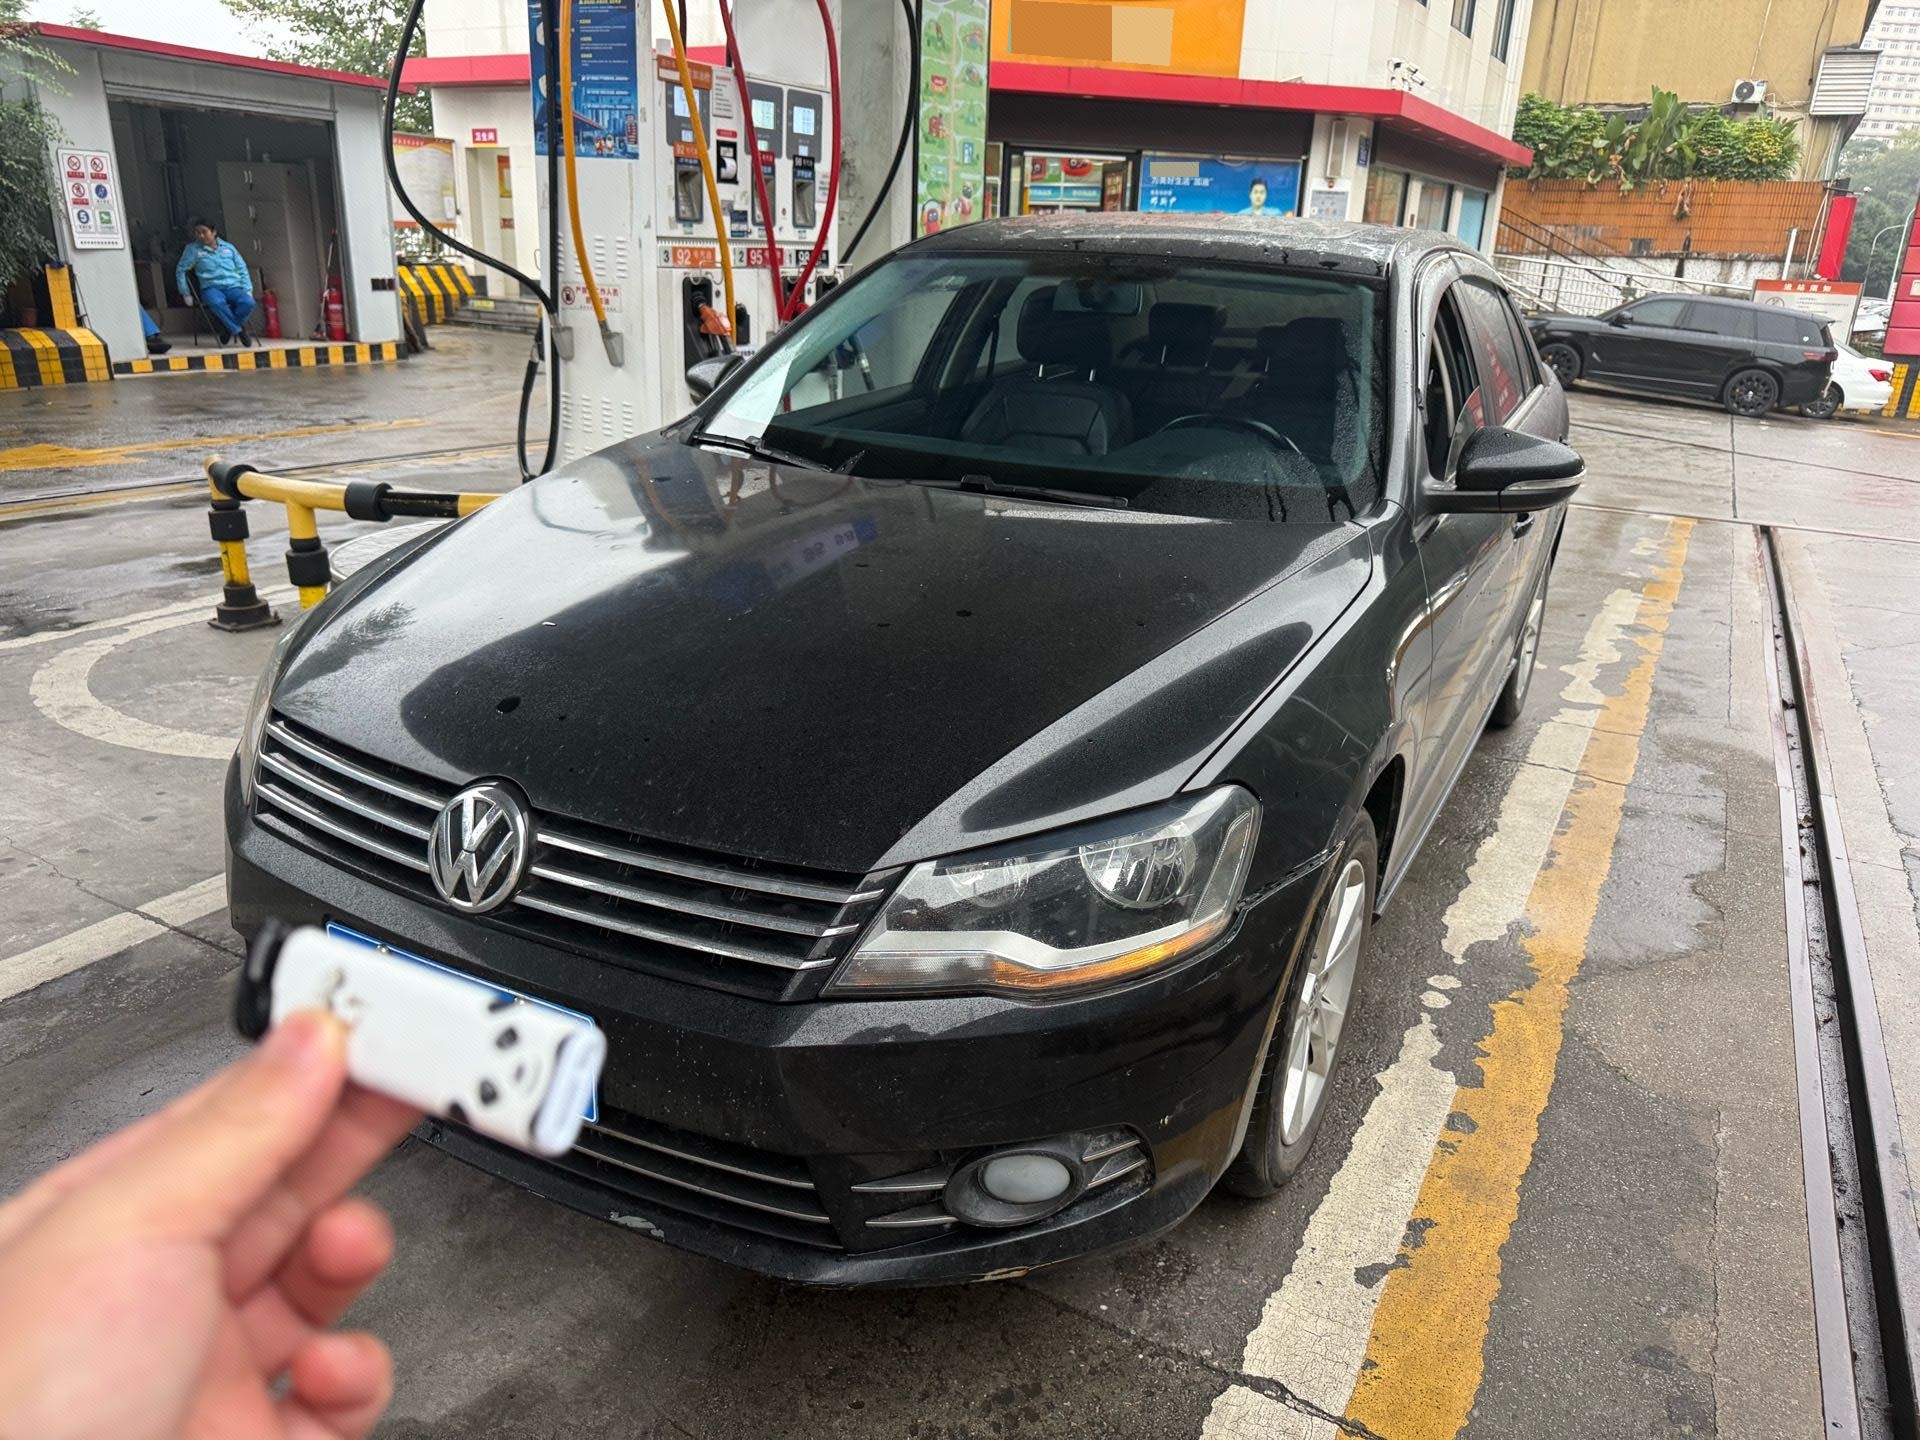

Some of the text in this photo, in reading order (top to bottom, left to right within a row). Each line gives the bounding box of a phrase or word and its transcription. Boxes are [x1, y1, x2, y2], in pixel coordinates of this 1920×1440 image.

[663, 250, 670, 263] 3
[738, 251, 745, 263] 2
[788, 251, 793, 264] 1
